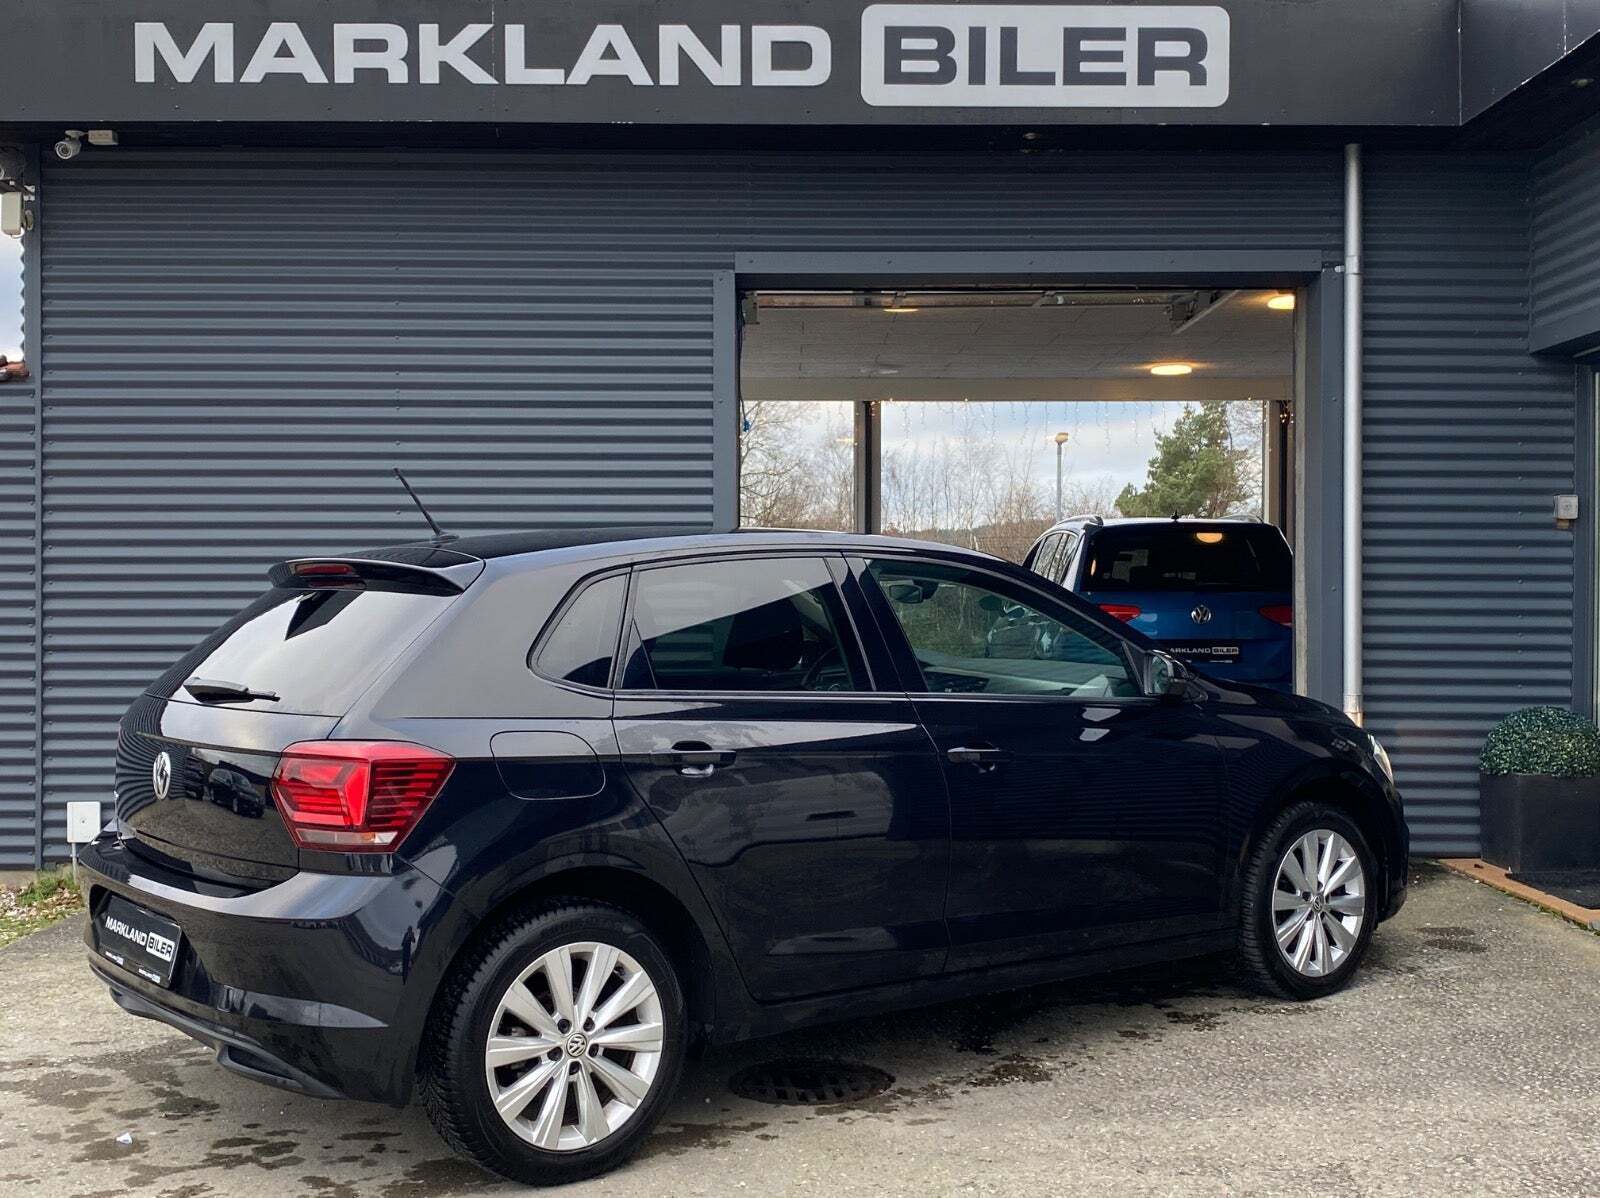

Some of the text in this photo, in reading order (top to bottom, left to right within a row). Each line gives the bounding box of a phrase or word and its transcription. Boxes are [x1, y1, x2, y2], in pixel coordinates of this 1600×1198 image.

[134, 22, 1209, 86] MARKLAND BILER
[105, 916, 173, 957] MARKLAND BILER
